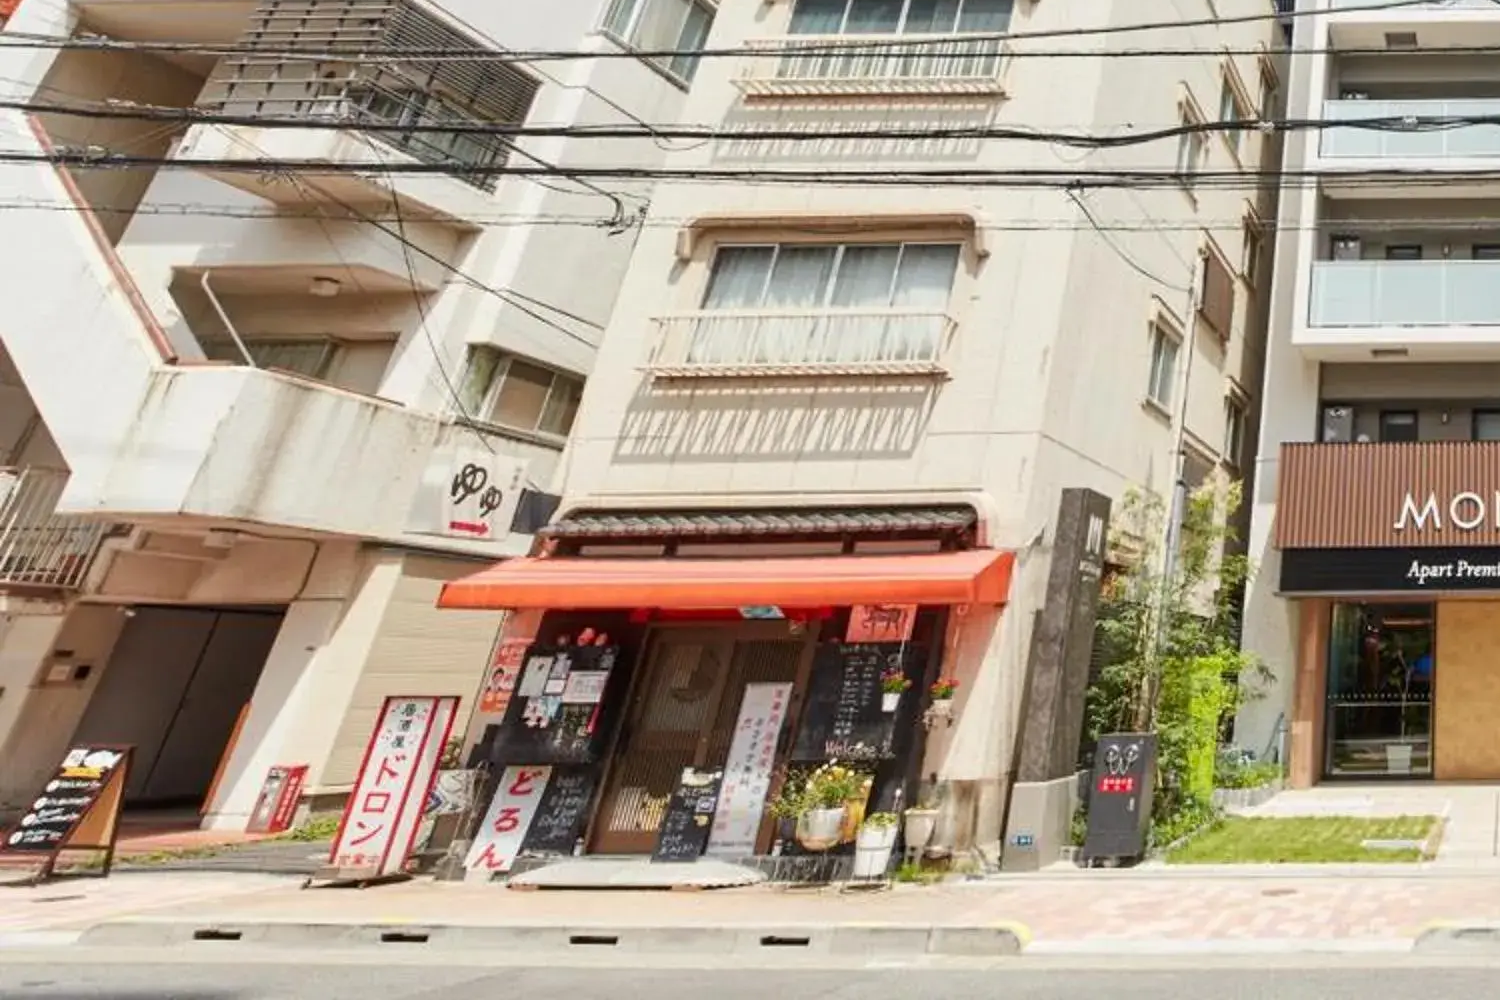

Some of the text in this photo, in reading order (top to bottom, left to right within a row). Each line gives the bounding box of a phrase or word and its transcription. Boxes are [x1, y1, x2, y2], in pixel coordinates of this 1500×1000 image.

[1406, 560, 1453, 584] Apart
[473, 767, 543, 869] どろん
